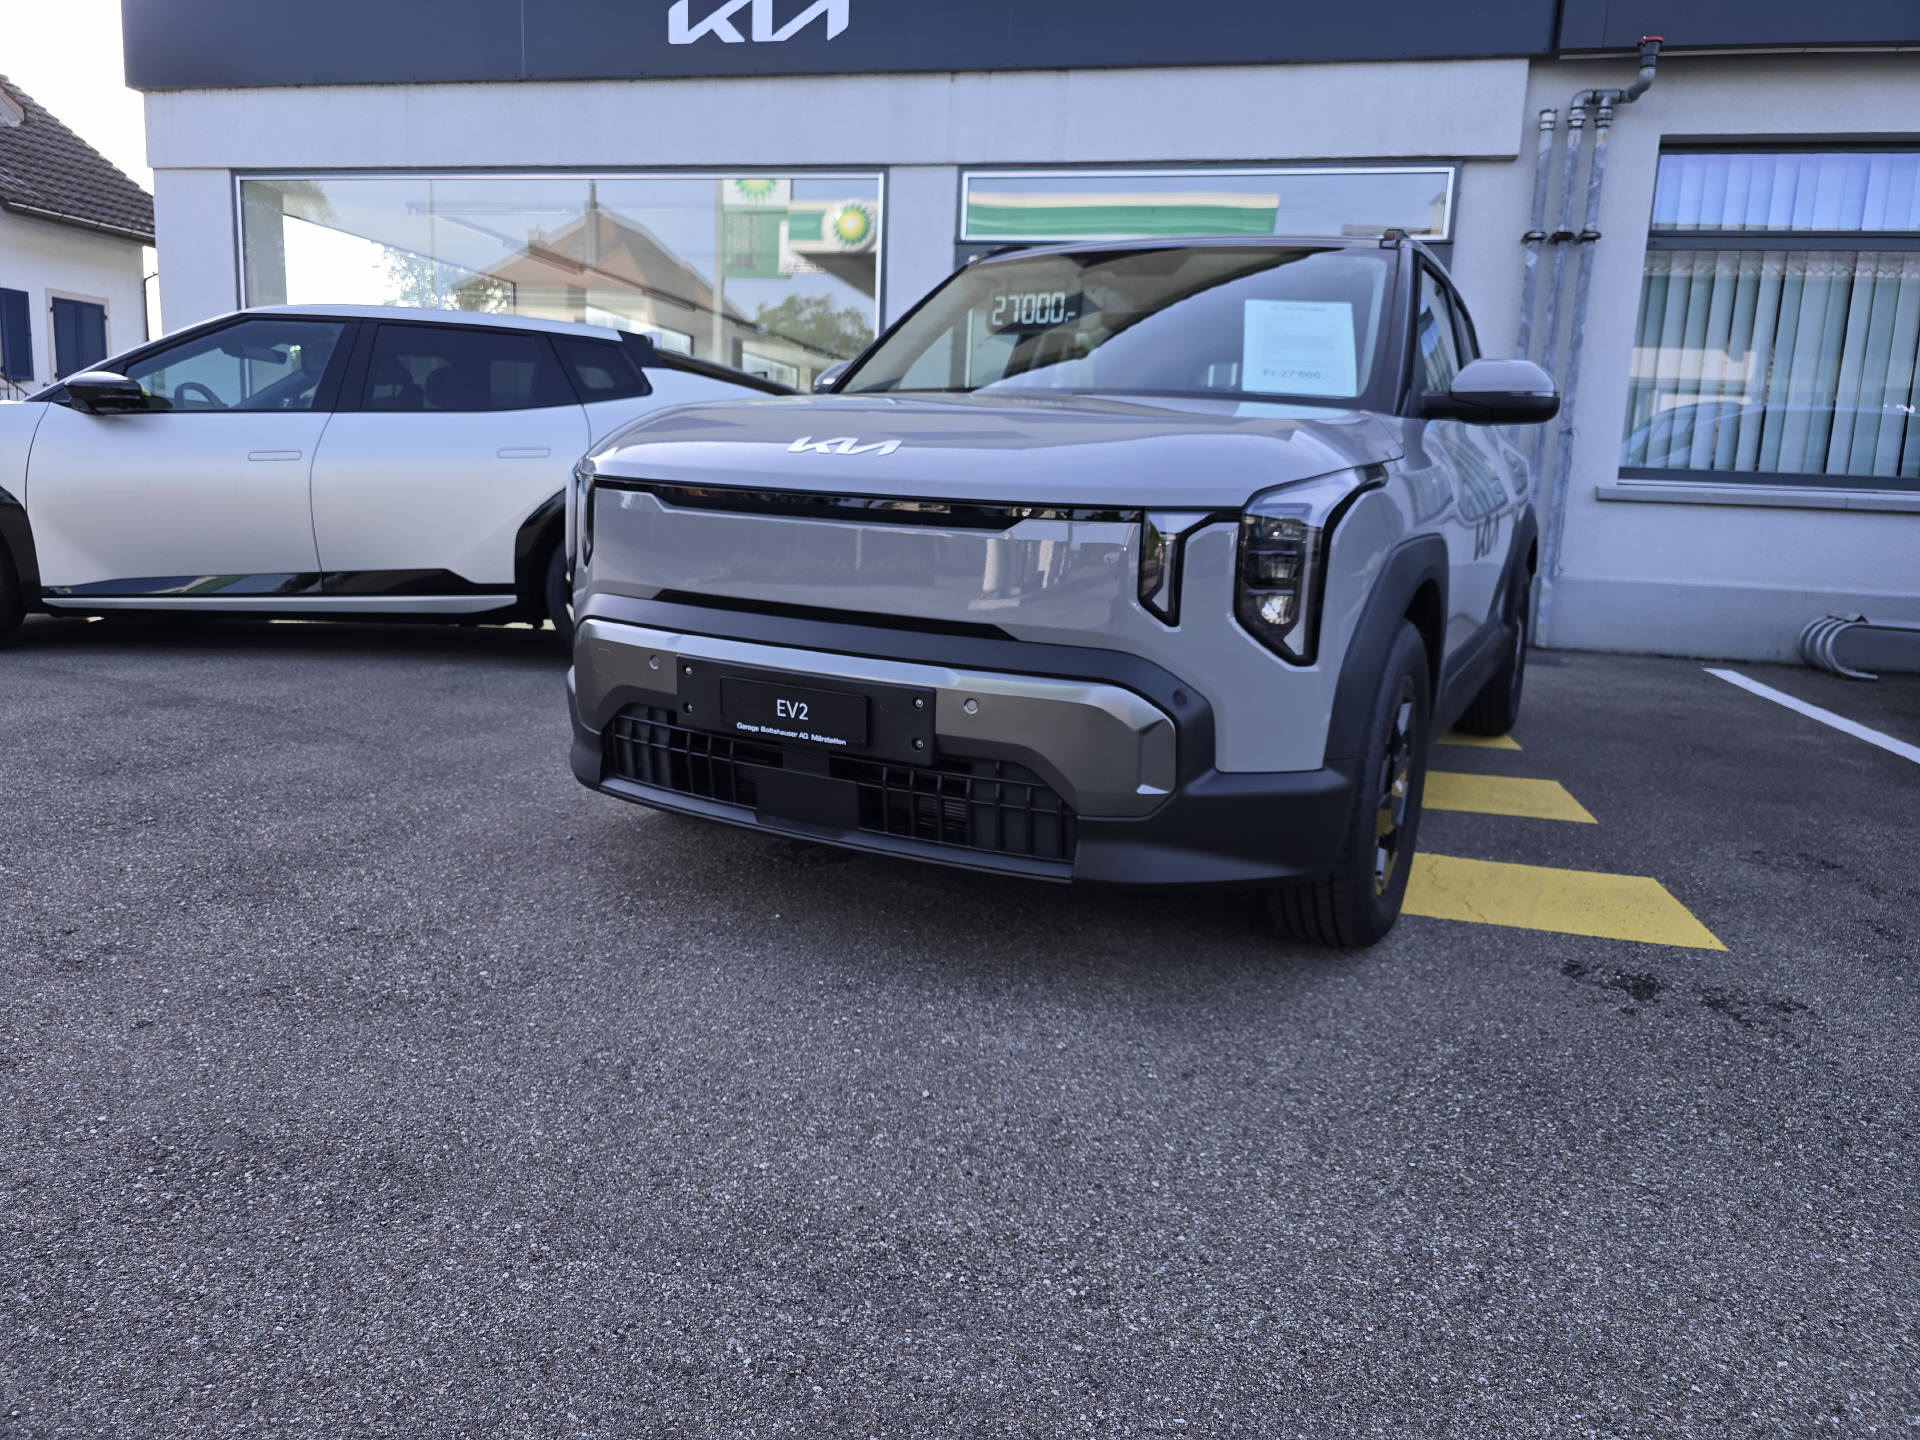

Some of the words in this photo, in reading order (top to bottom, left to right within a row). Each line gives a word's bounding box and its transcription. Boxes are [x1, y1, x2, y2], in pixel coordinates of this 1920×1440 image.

[668, 0, 850, 44] KIA
[787, 435, 903, 456] KIA
[776, 699, 809, 720] EV2
[737, 722, 760, 732] Garage
[798, 731, 809, 740] AG
